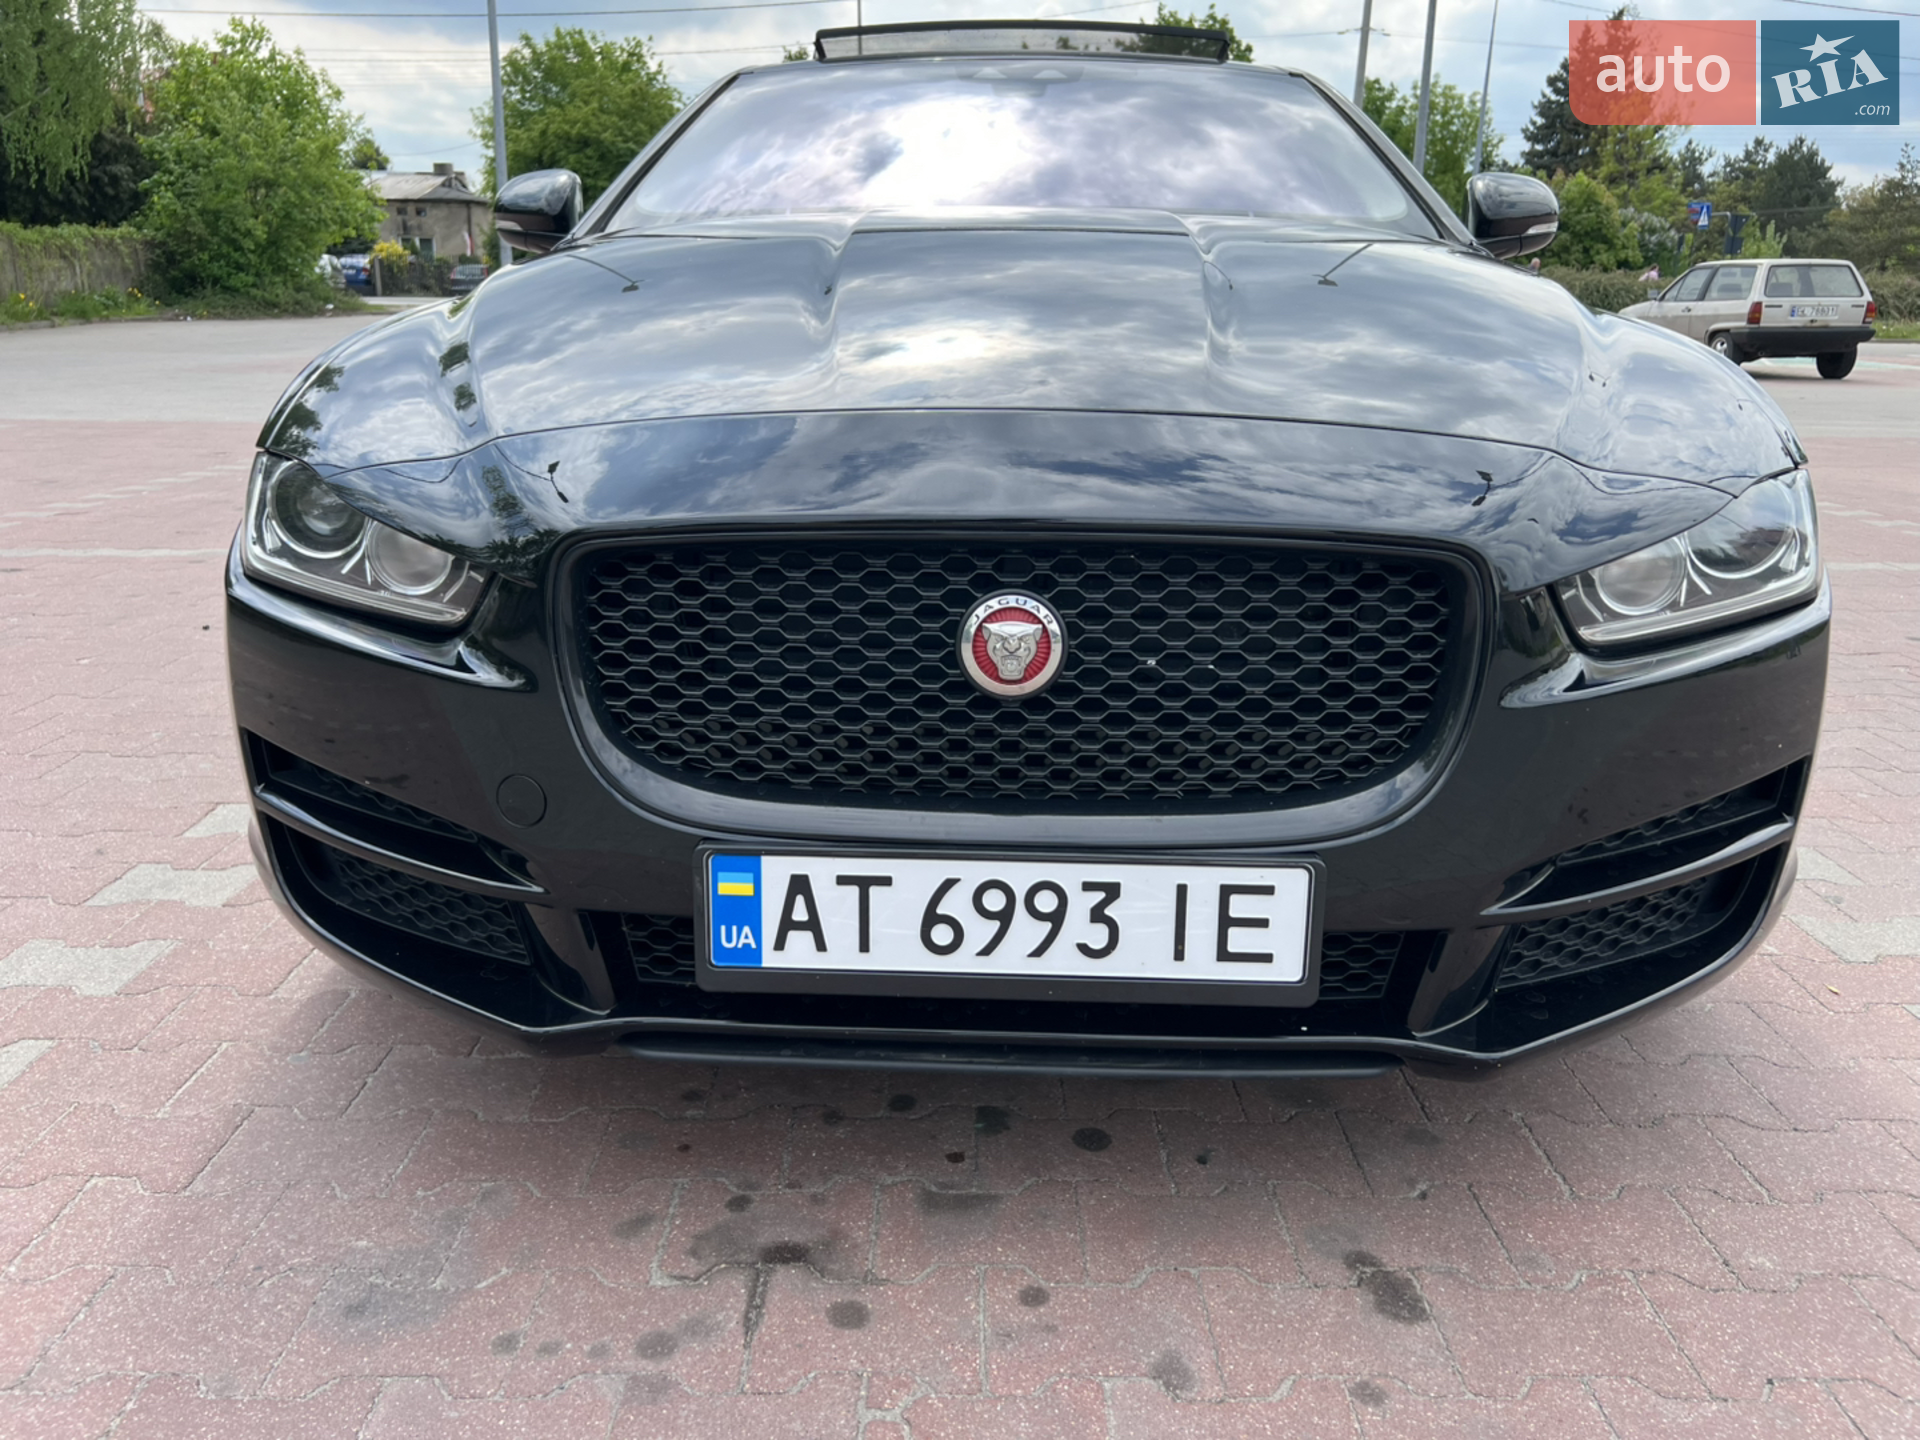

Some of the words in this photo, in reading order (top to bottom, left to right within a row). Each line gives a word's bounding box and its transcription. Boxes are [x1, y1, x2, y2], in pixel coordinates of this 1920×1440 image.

[973, 597, 1054, 626] JAGUAR
[773, 874, 893, 953] AT
[920, 878, 1121, 960] 6993
[1173, 883, 1276, 964] IE
[720, 925, 757, 949] UA
